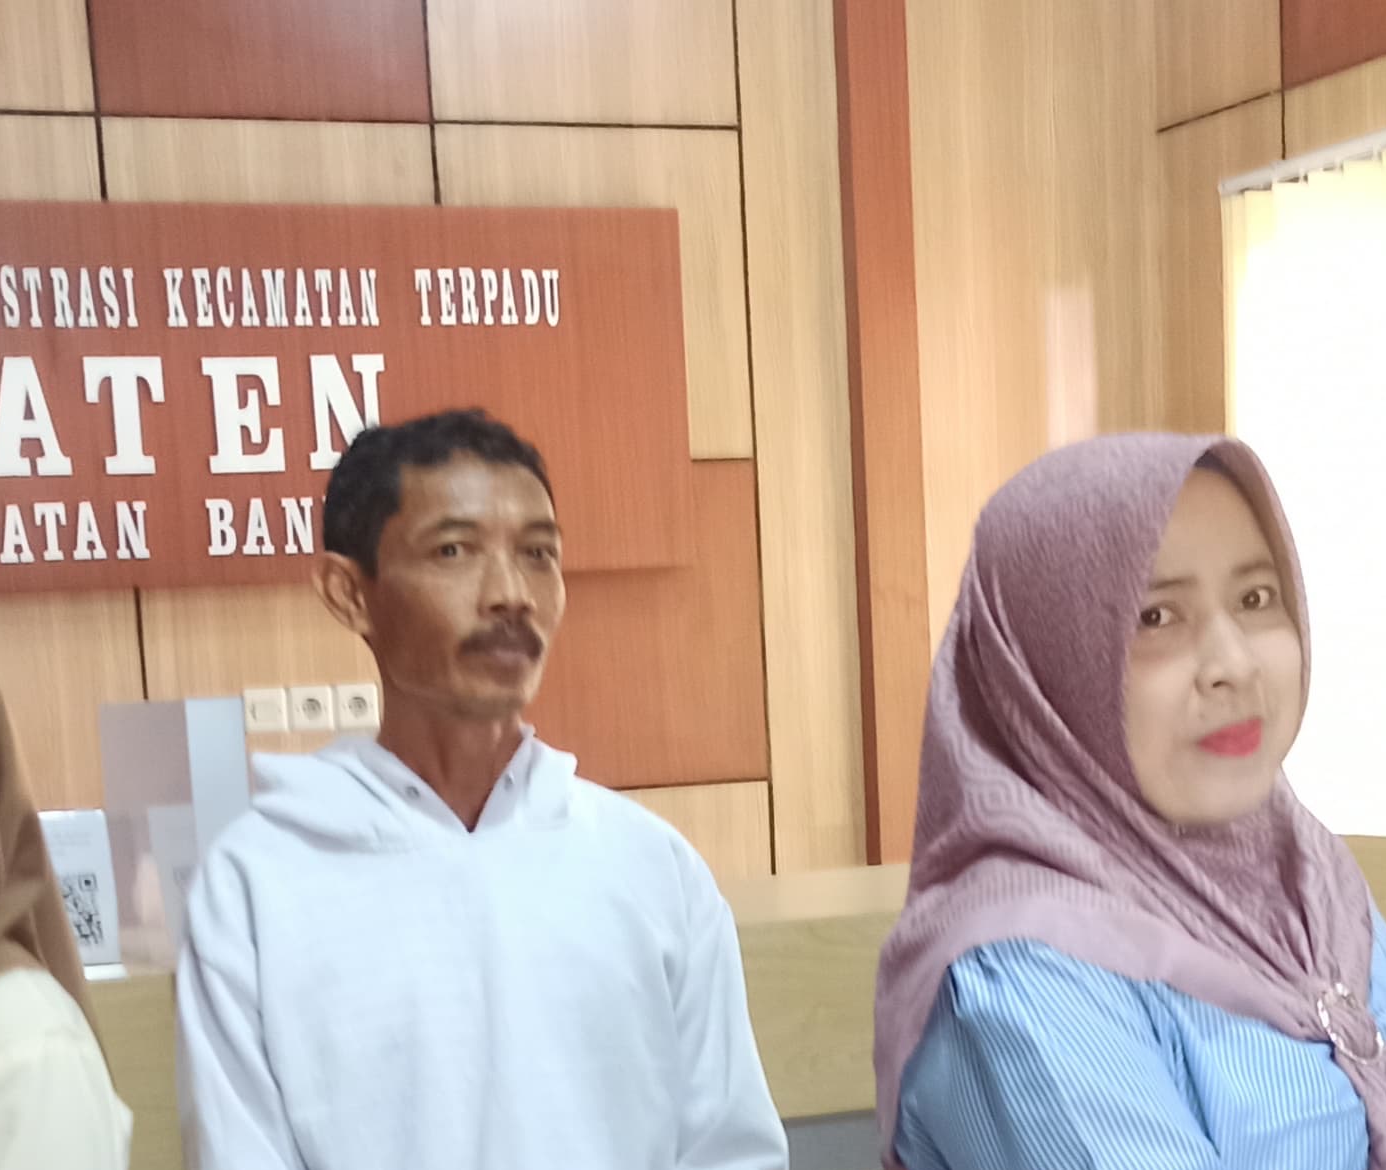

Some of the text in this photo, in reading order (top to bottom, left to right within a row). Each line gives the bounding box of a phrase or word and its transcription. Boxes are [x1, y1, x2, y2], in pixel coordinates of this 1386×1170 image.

[163, 267, 380, 328] KECAMATAN
[414, 268, 561, 327] TERPADU
[205, 496, 327, 556] BAN
